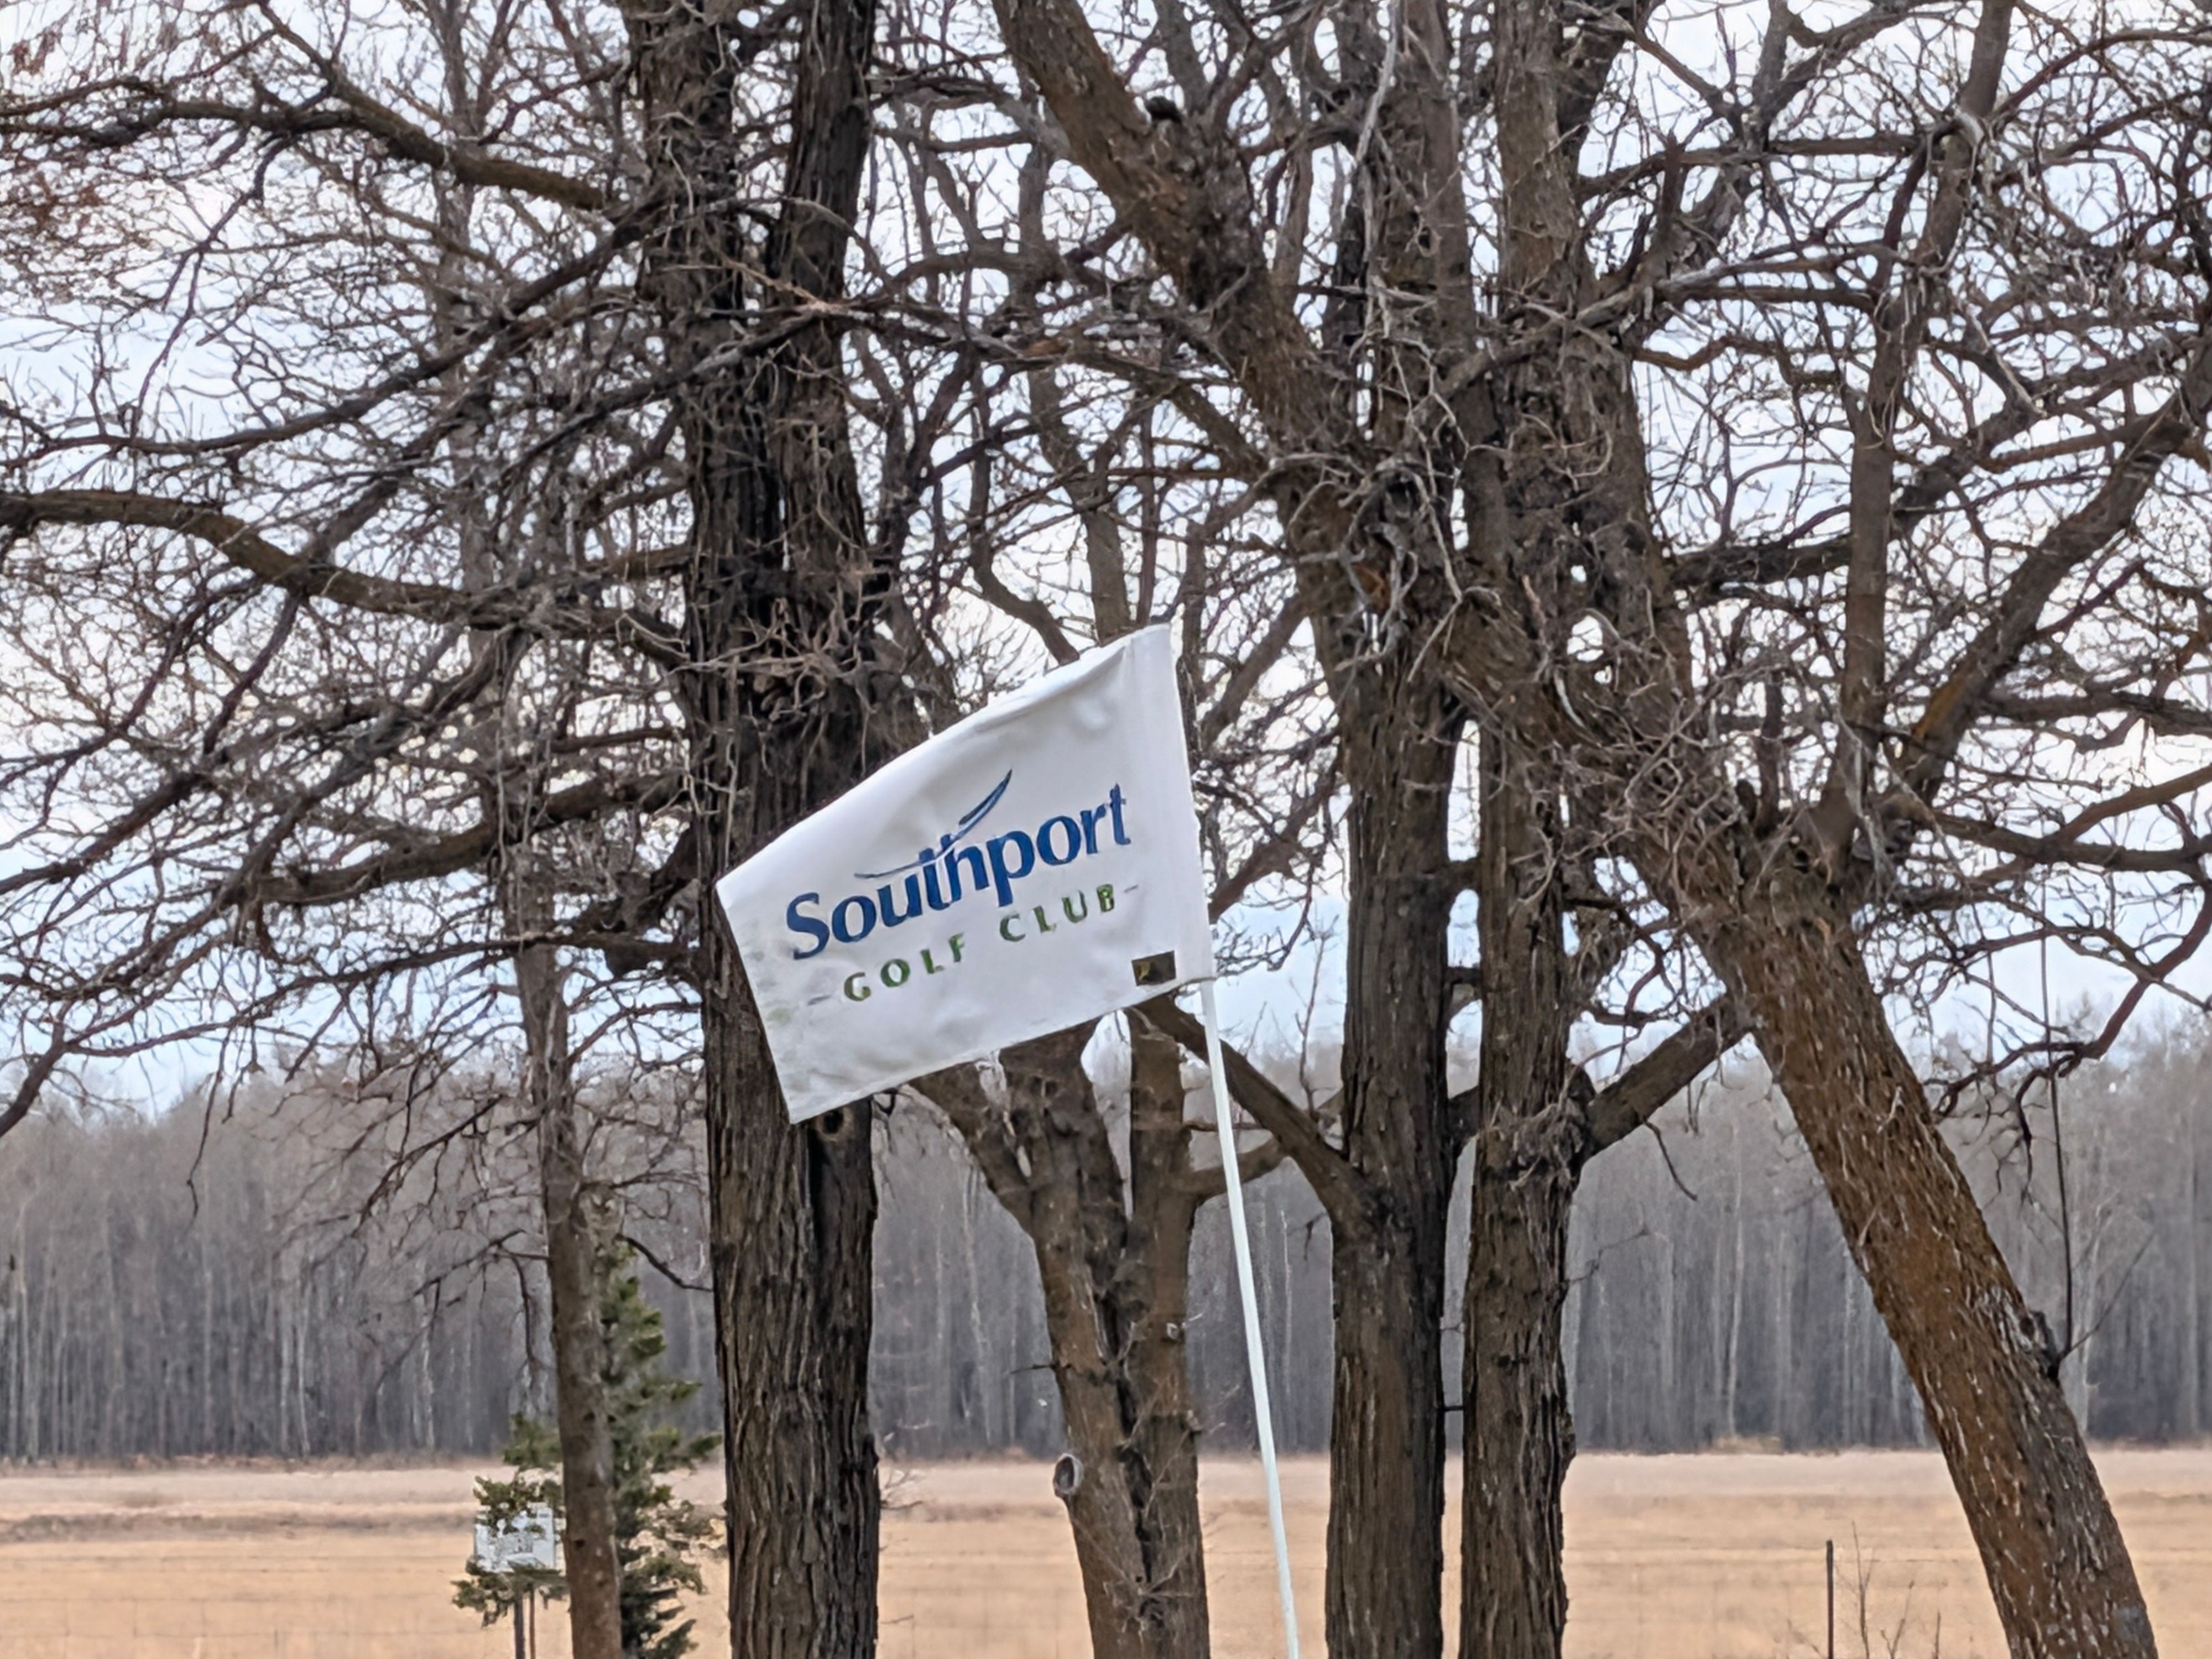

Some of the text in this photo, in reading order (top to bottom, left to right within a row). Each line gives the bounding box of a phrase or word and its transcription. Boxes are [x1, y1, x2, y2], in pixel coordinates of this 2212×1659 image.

[786, 782, 1131, 960] Southport
[844, 883, 1116, 1001] GOLF CLUB
